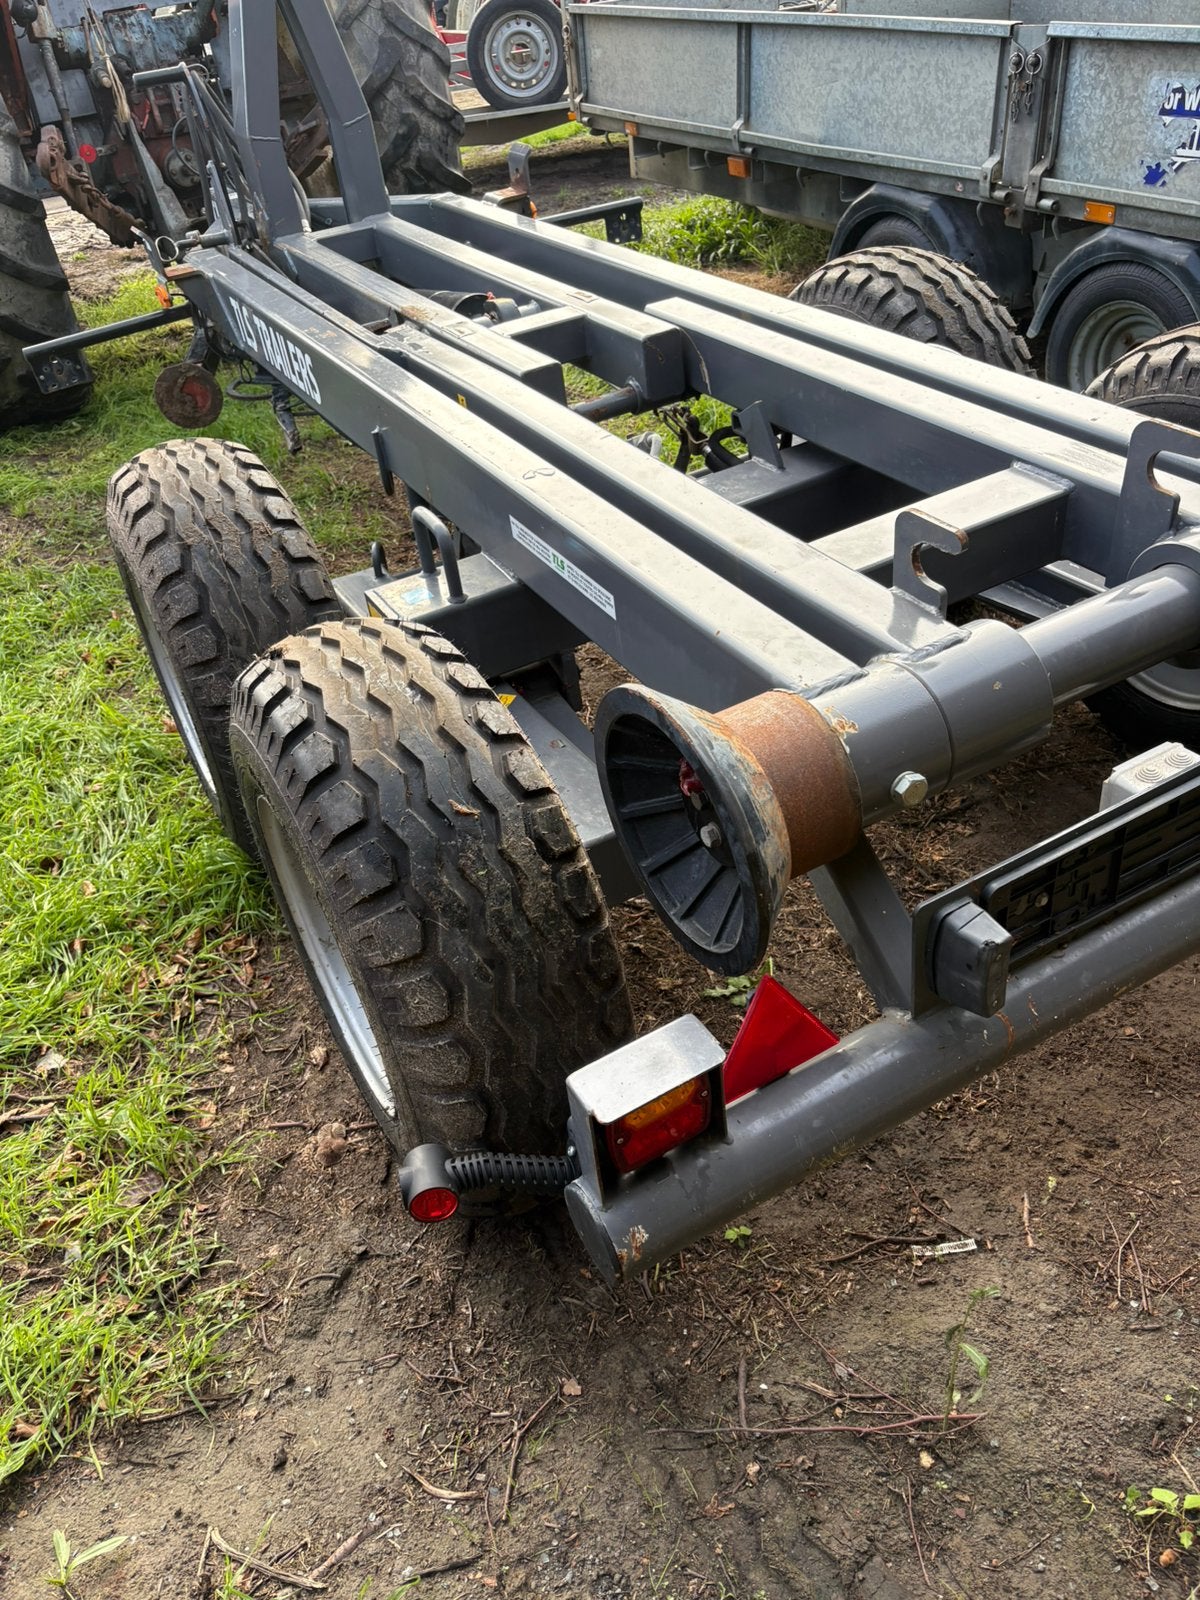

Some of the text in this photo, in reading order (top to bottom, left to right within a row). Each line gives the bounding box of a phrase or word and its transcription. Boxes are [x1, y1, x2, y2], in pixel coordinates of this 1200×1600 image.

[229, 296, 322, 405] TLS TRAILERS
[551, 552, 566, 571] TLS
